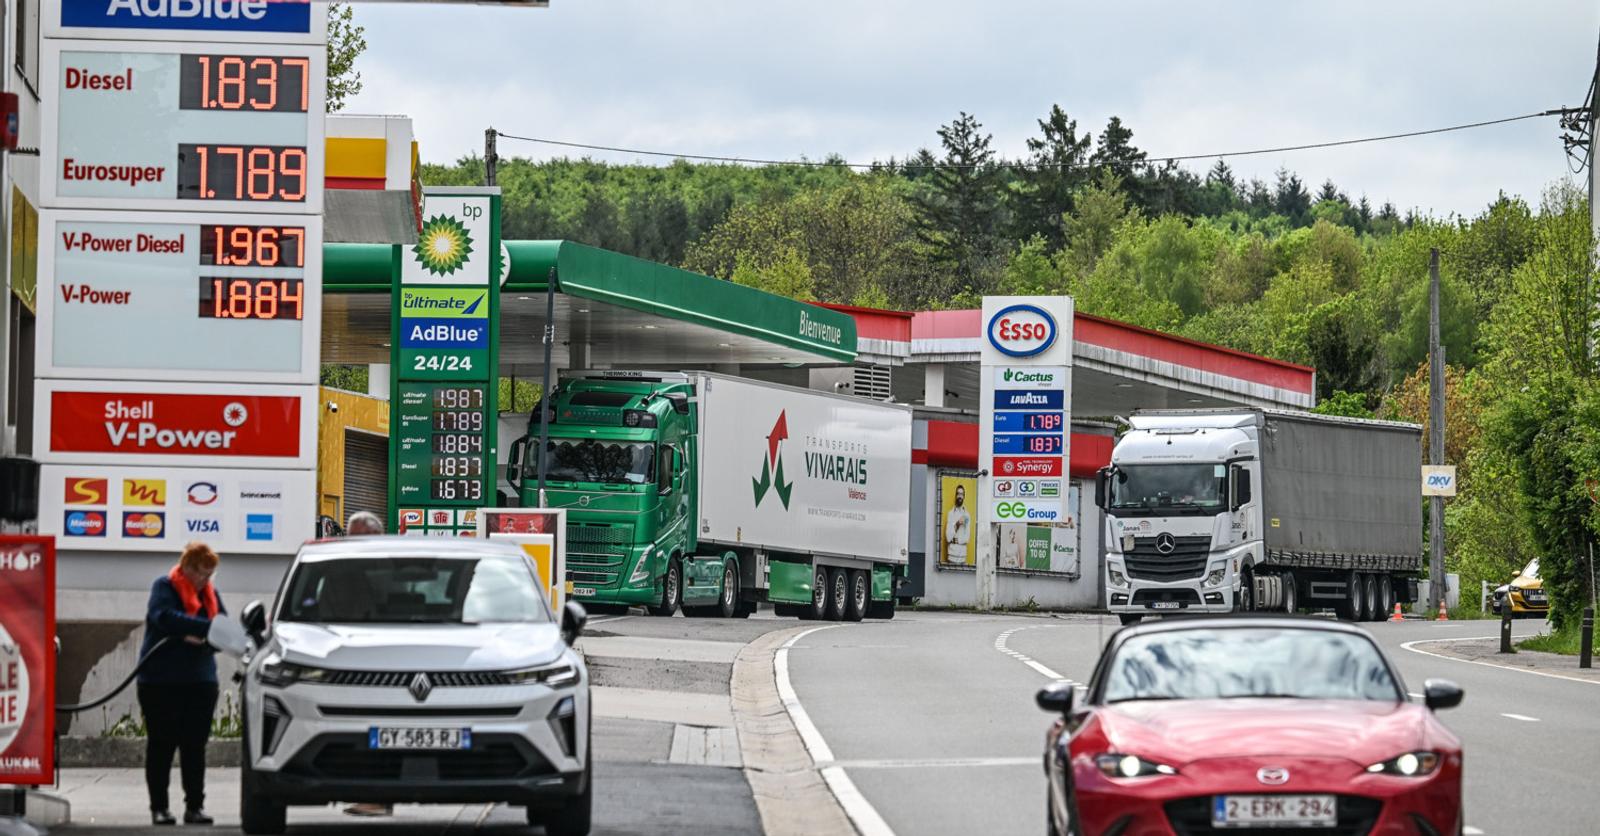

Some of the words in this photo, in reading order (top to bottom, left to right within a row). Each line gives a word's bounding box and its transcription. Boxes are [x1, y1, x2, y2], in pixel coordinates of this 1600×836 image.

[65, 67, 132, 90] Diesel
[199, 57, 310, 111] 1.837
[63, 159, 165, 186] Eurosuper
[196, 147, 307, 200] 1.789
[463, 203, 482, 221] bp
[63, 232, 132, 252] V-Power
[137, 233, 185, 253] Diesel
[215, 227, 304, 266] 1.967
[61, 284, 131, 304] V-Power
[214, 280, 303, 319] 1.884
[404, 292, 413, 300] bp
[404, 296, 466, 309] ultimate
[410, 325, 479, 341] AdBlue
[799, 310, 841, 344] Bienvenue
[999, 319, 1046, 340] Esso
[413, 355, 472, 371] 24/24
[1014, 371, 1054, 382] Cactus
[440, 389, 483, 408] 1.987
[1010, 392, 1048, 404] LAVAZZA
[104, 400, 153, 420] Shell
[440, 412, 483, 431] 1.789
[105, 422, 236, 449] V-Power
[440, 435, 482, 454] 1.884
[806, 436, 867, 454] TRANSPORTS
[1030, 437, 1060, 452] 1.837
[439, 457, 482, 476] 1.837
[805, 451, 867, 484] VIVARAIS
[1017, 462, 1053, 473] Synergy
[439, 480, 482, 499] 1.673
[1428, 475, 1451, 486] DKV
[70, 518, 101, 528] Maestro
[1027, 508, 1057, 519] Group
[187, 520, 219, 533] VISA
[1028, 539, 1048, 549] COFFEE
[1030, 548, 1038, 558] TO
[1038, 549, 1046, 558] GO
[1058, 544, 1074, 553] Cactus
